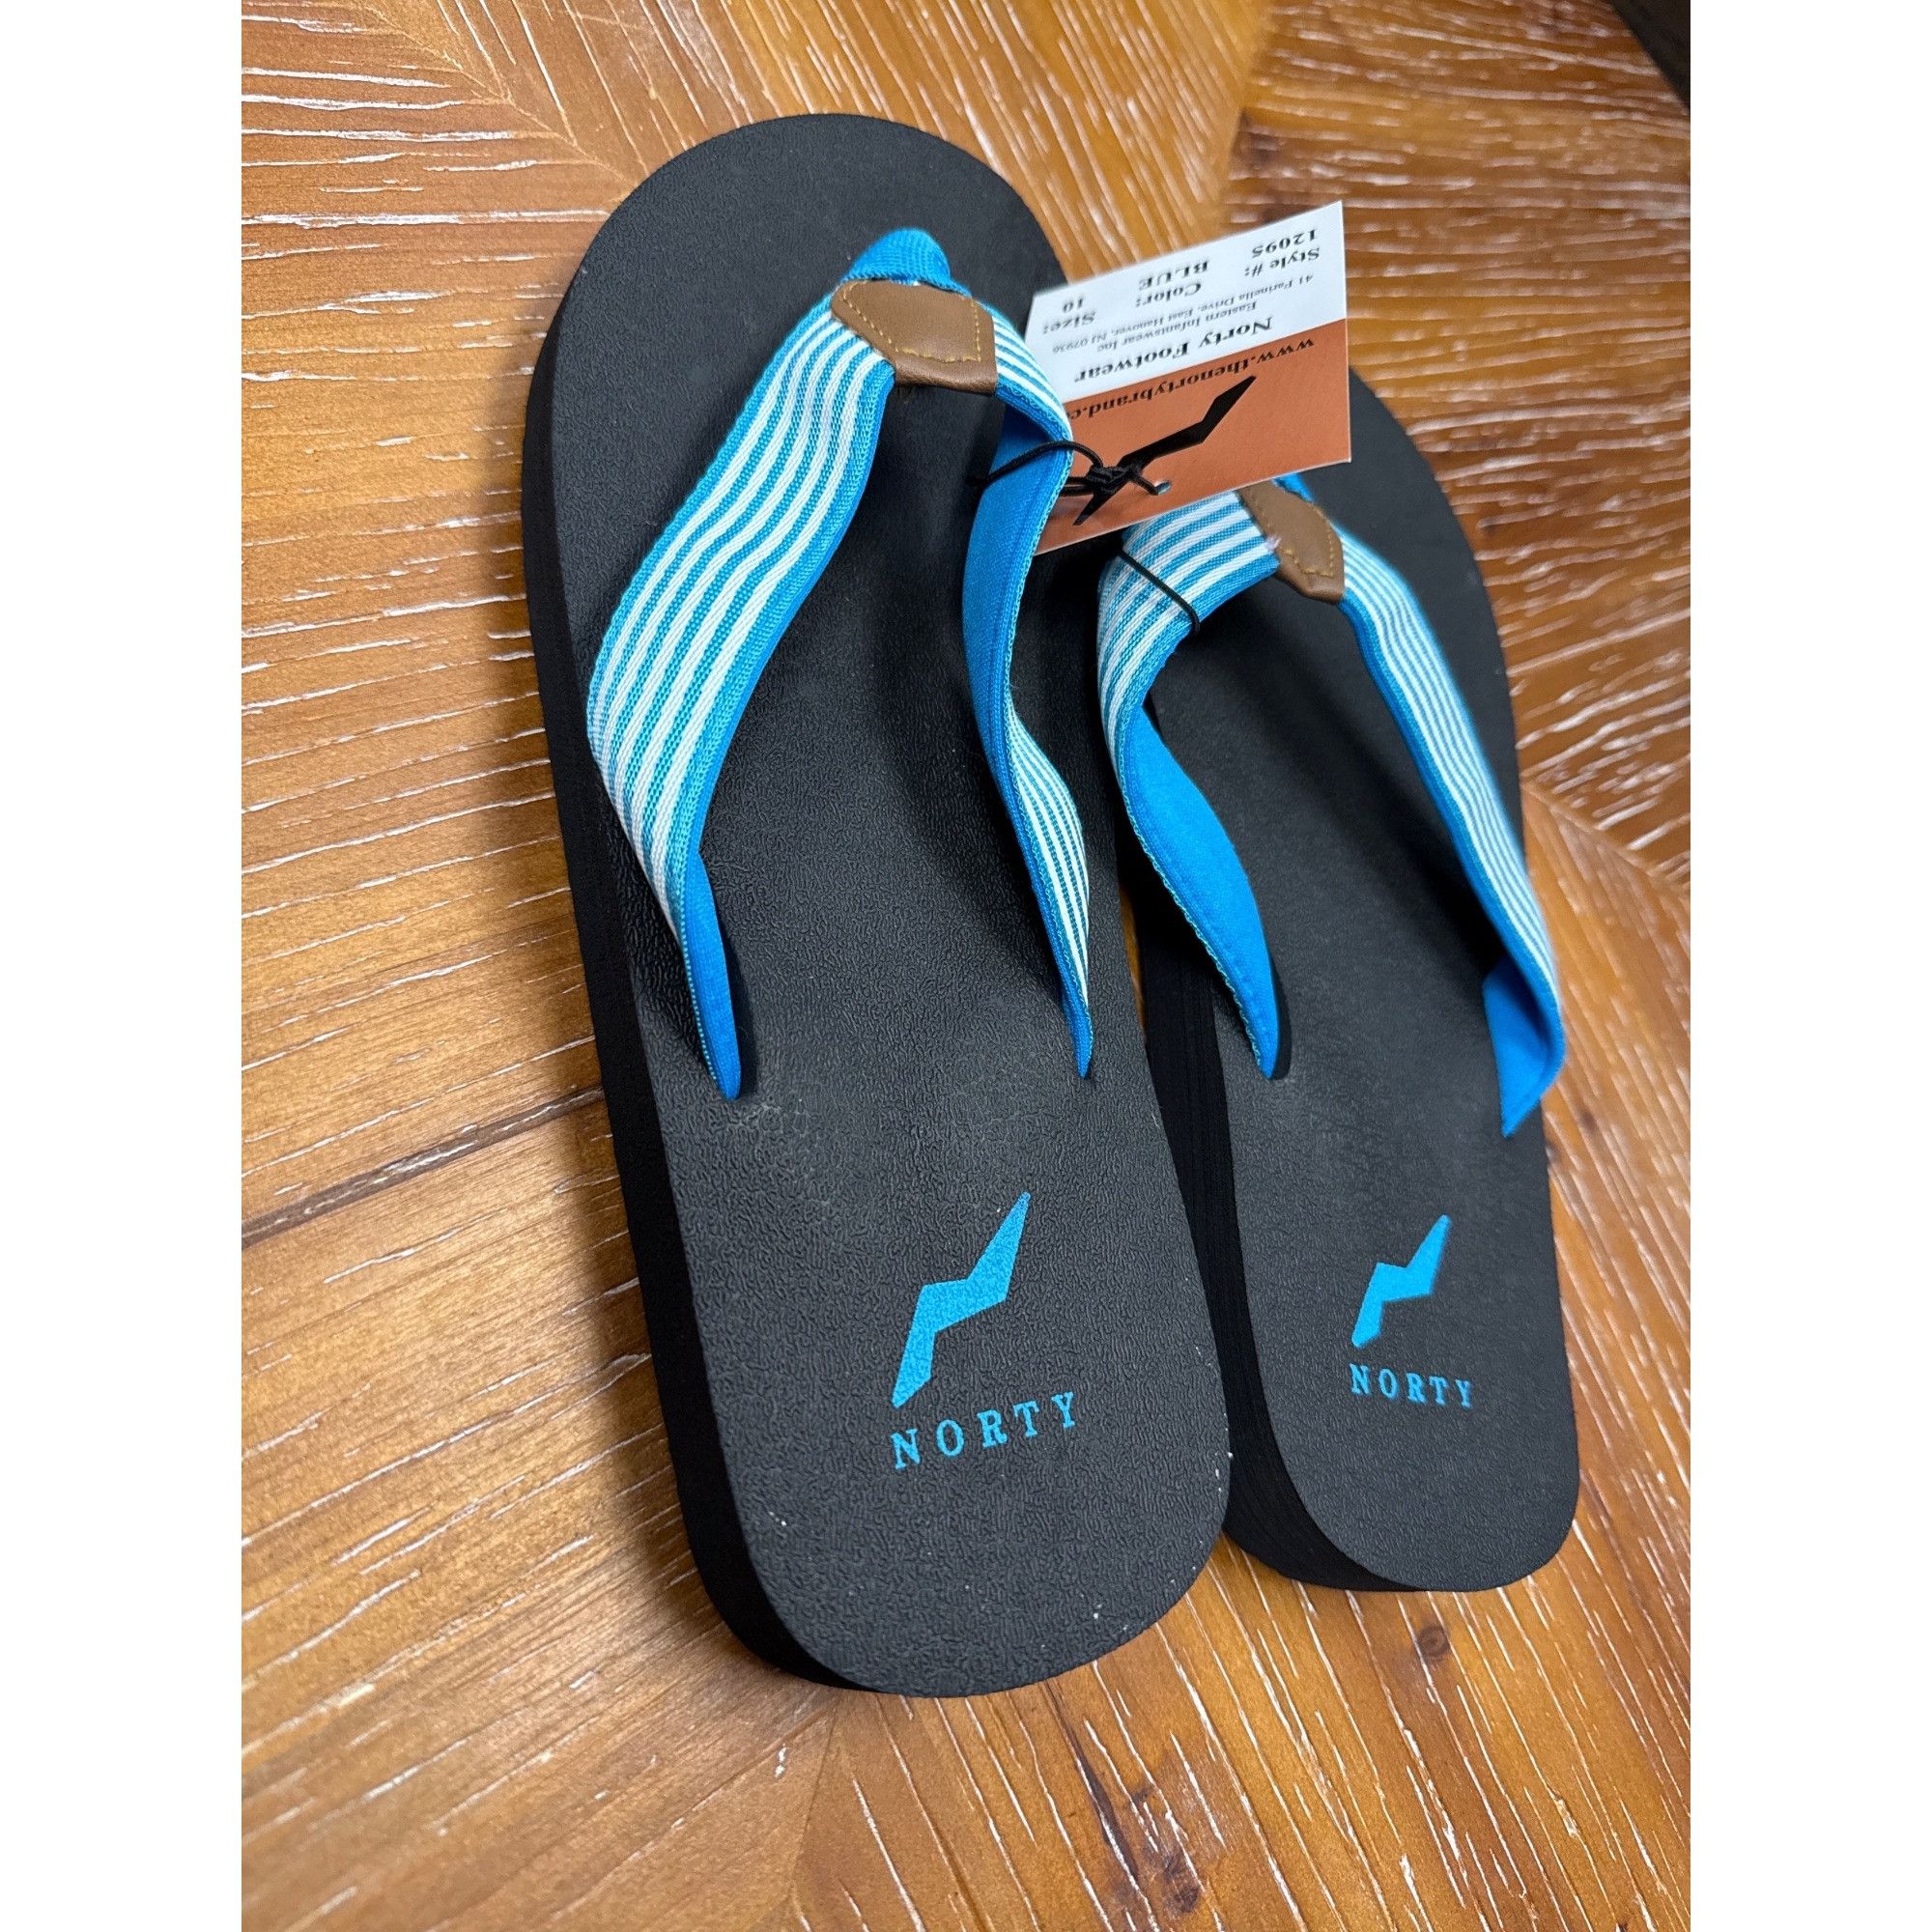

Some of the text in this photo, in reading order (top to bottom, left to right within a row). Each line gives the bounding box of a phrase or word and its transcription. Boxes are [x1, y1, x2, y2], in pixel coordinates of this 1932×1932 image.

[1251, 229, 1317, 258] 12095
[1138, 260, 1208, 290] BLUE
[1244, 247, 1320, 277] Style #:
[1238, 279, 1293, 301] Farinella
[1299, 274, 1313, 285] 41
[1063, 298, 1084, 313] 10
[1136, 283, 1202, 307] Color:
[1042, 311, 1096, 334] Size:
[1097, 301, 1257, 353] Eastern Infantswear Inc
[1169, 309, 1193, 320] East
[1074, 317, 1272, 383] Norty Footwear
[1091, 332, 1107, 342] NJ
[1350, 1363, 1473, 1408] NORTY
[890, 1391, 1076, 1469] NORTY
